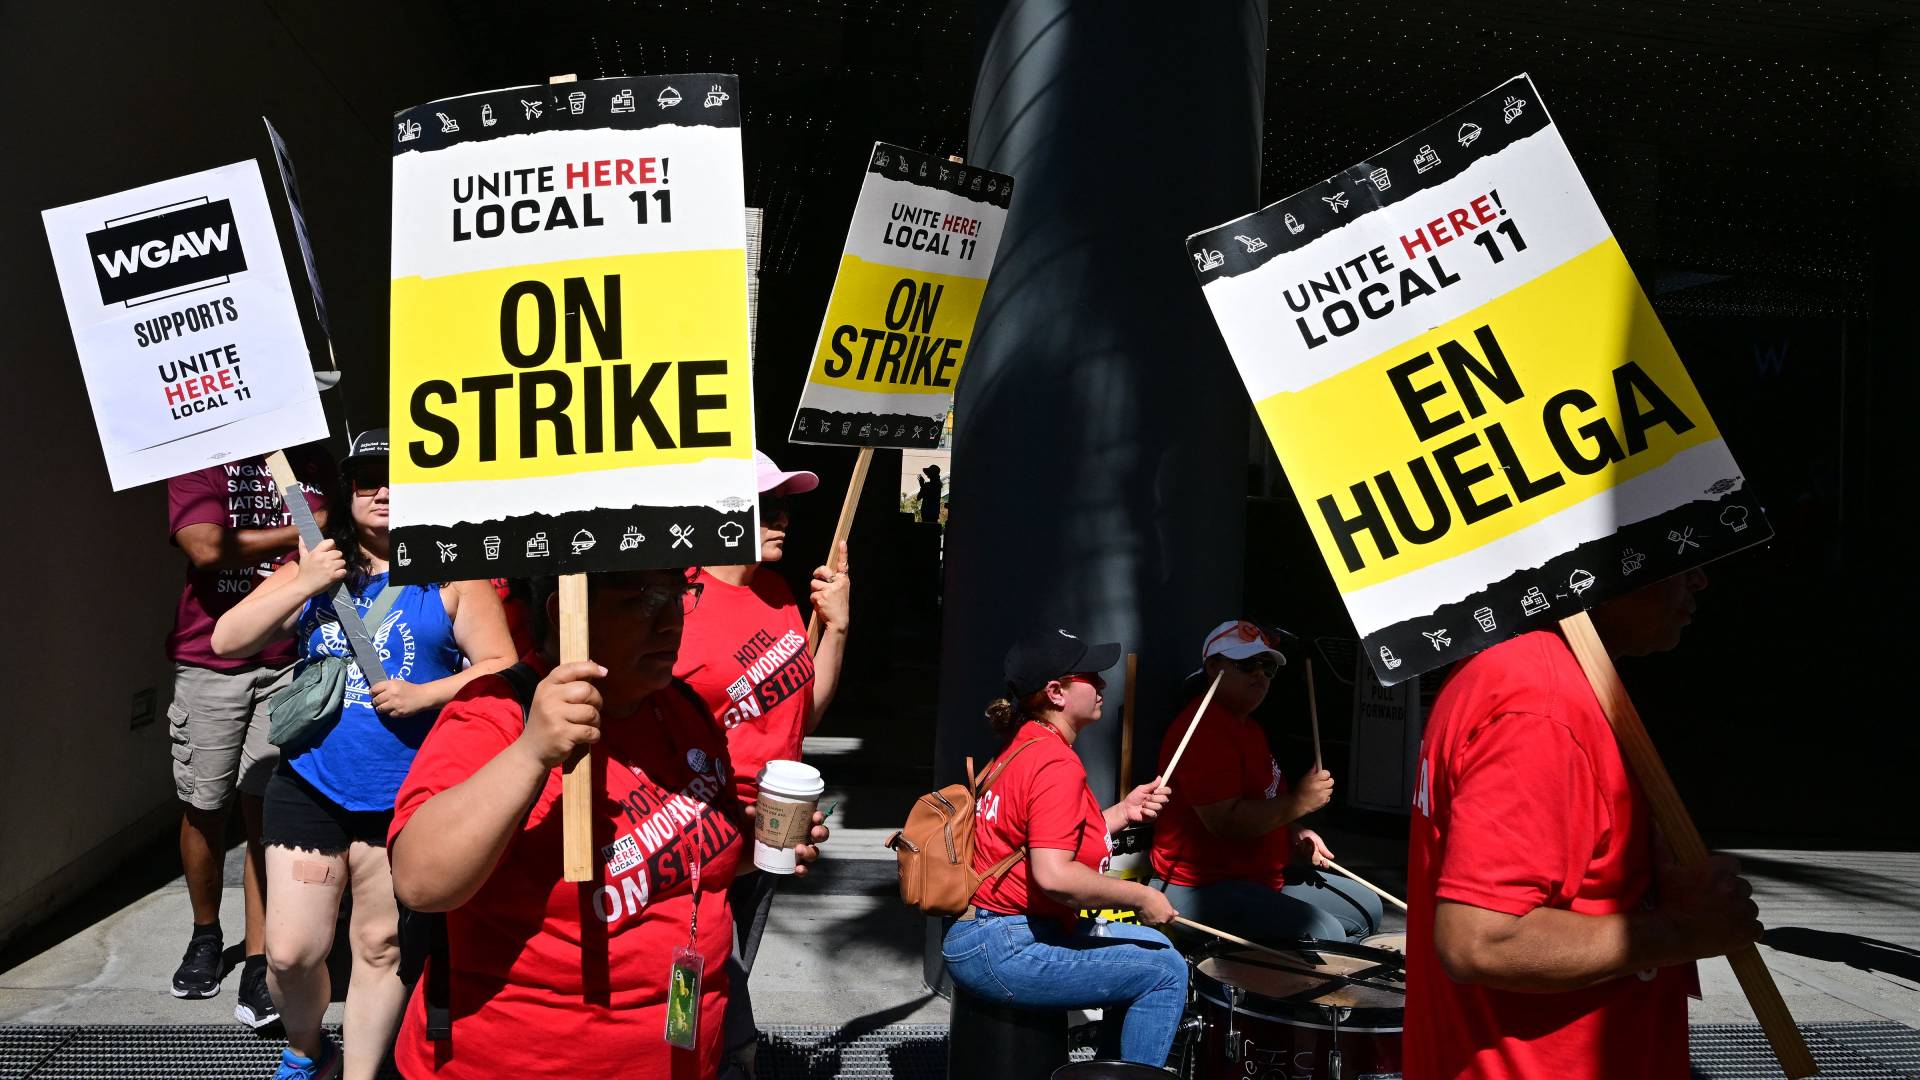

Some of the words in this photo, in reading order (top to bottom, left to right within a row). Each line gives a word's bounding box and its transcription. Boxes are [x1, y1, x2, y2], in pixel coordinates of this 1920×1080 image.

[453, 165, 555, 204] UNITE
[566, 157, 670, 190] HERE!
[452, 192, 604, 242] LOCAL
[630, 189, 672, 225] 11
[891, 202, 941, 229] UNITE
[942, 214, 982, 238] HERE!
[97, 223, 230, 279] WGAW
[883, 223, 950, 256] LOCAL
[960, 238, 977, 260] 11
[1282, 245, 1395, 312] UNITE
[1399, 189, 1508, 260] HERE!
[884, 278, 945, 334] ON
[1295, 255, 1461, 349] LOCAL
[1473, 218, 1528, 264] 11
[133, 296, 239, 348] SUPPORTS
[499, 274, 623, 369] ON
[158, 344, 241, 383] UNITE
[824, 324, 963, 388] STRIKE
[164, 366, 244, 406] HERE!
[171, 393, 229, 420] LOCAL
[234, 387, 252, 401] 11
[1386, 324, 1525, 442] EN
[408, 359, 732, 469] STRIKE
[1317, 361, 1696, 574] HUELGA
[733, 628, 777, 668] HOTEL
[746, 629, 805, 685] WORKERS
[345, 692, 363, 700] EST
[727, 676, 747, 694] UNITE
[761, 649, 815, 707] STRIK
[1372, 686, 1394, 701] PULL
[724, 695, 761, 729] ON
[1360, 703, 1405, 721] FORWARD
[603, 836, 635, 857] UNITE
[608, 846, 639, 867] HERE!
[611, 860, 634, 874] LOCAL
[658, 811, 736, 888] STRIK
[593, 869, 649, 923] ON
